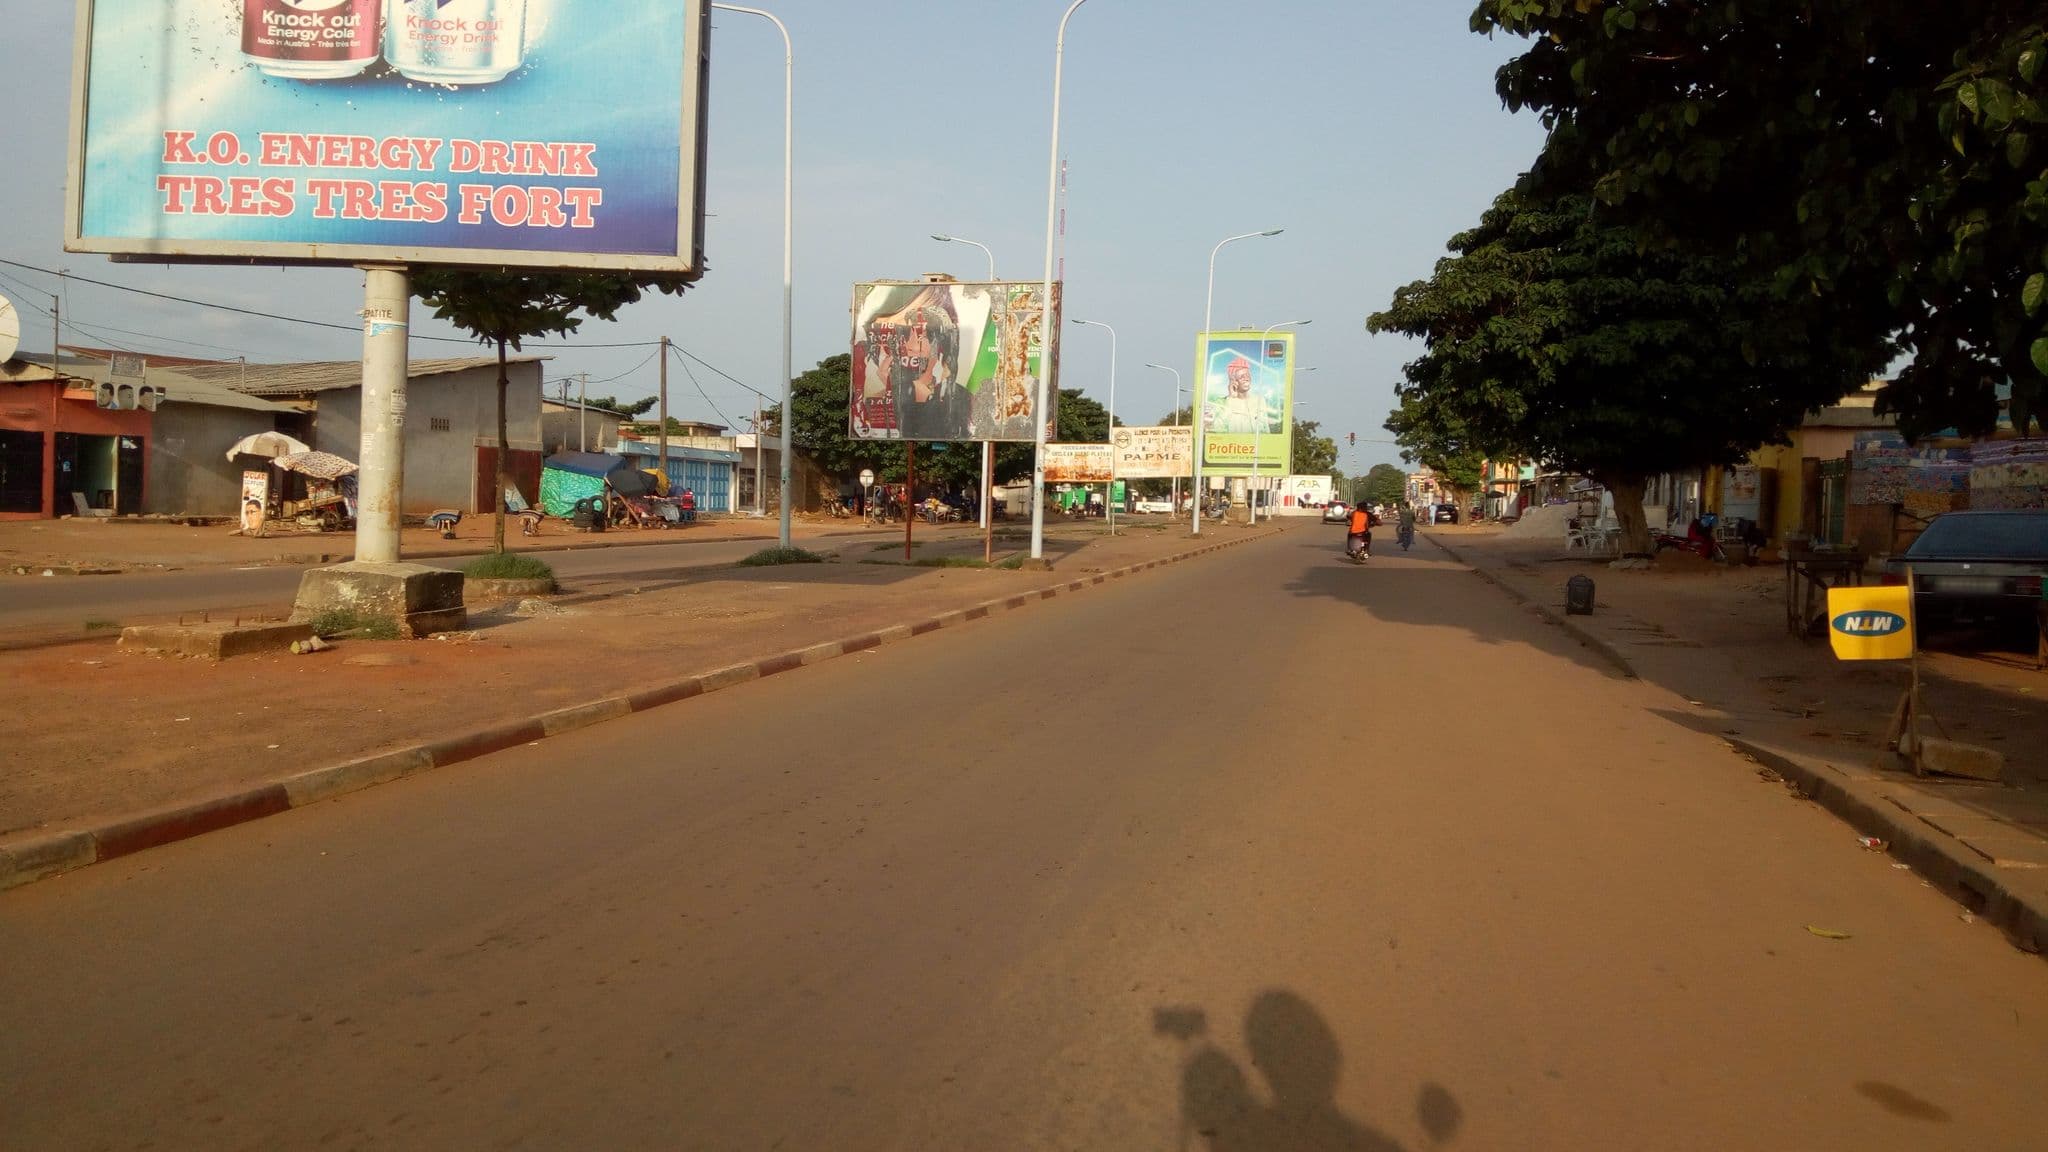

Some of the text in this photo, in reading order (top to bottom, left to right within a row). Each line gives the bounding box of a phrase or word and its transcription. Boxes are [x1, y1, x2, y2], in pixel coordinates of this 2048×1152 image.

[262, 10, 361, 27] Knock out
[406, 15, 471, 31] Knock
[267, 26, 355, 41] Energy Cola
[409, 31, 499, 45] Energy Drink
[257, 36, 275, 46] Made
[284, 40, 310, 48] Austria
[162, 130, 598, 177] K.O. ENERGY DRINK
[157, 174, 602, 229] TRES TRES FORT
[1209, 443, 1256, 454] Profitez
[1124, 453, 1181, 461] PAPME
[1845, 616, 1893, 632] MTN
